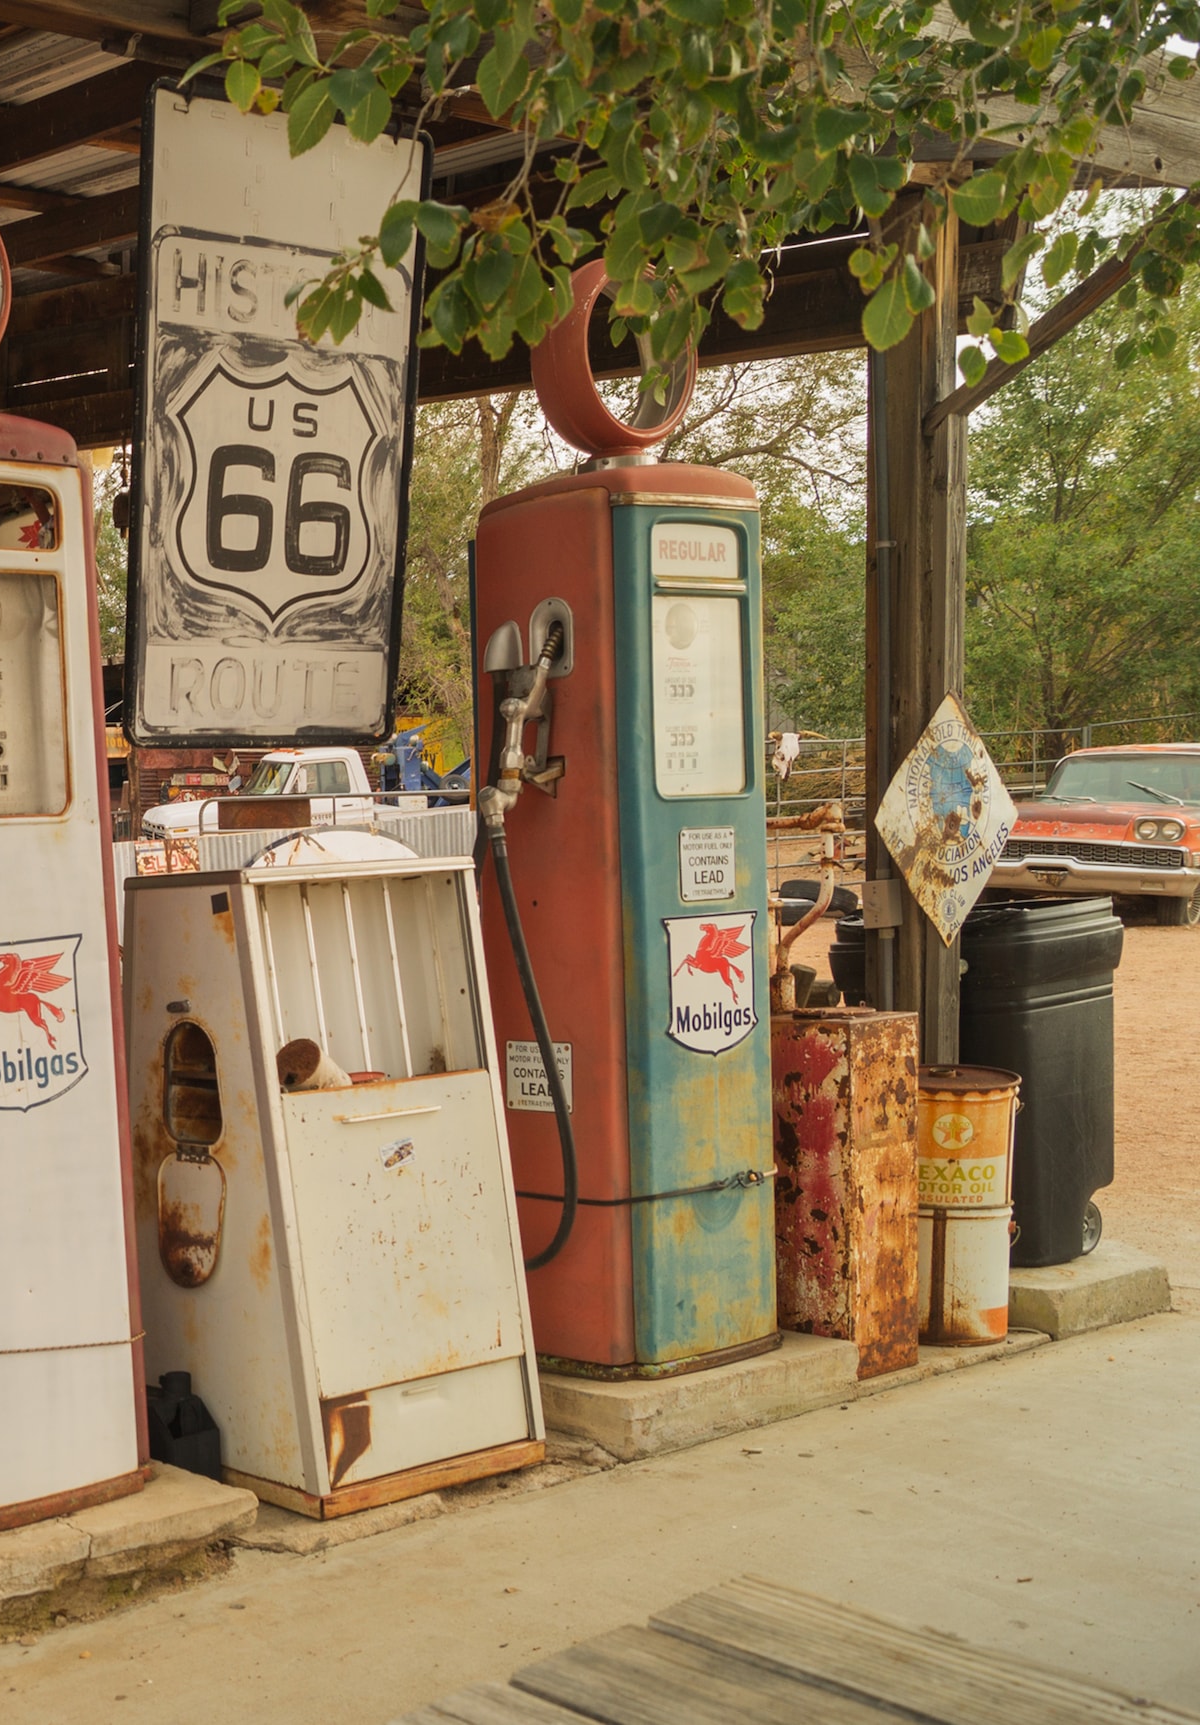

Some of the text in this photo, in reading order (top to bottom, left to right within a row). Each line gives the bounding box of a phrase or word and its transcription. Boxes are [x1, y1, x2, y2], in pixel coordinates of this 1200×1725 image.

[247, 396, 319, 438] US
[205, 443, 352, 577] 66
[658, 538, 727, 563] REGULAR
[169, 656, 361, 719] ROUTE
[701, 832, 713, 840] USE
[703, 842, 718, 850] FUEL
[937, 830, 981, 863] OCIATION
[972, 822, 1009, 879] ANGELES
[688, 855, 730, 867] CONTAINS
[694, 869, 725, 885] LEAD
[676, 1001, 751, 1037] Mobilgas
[514, 1044, 563, 1054] FOR US A
[508, 1055, 569, 1065] MOTOR FU NLY
[513, 1066, 565, 1080] CONTAS
[918, 1163, 996, 1182] EXACO
[918, 1180, 994, 1195] OTOR OIL
[918, 1194, 984, 1204] NSULATED
